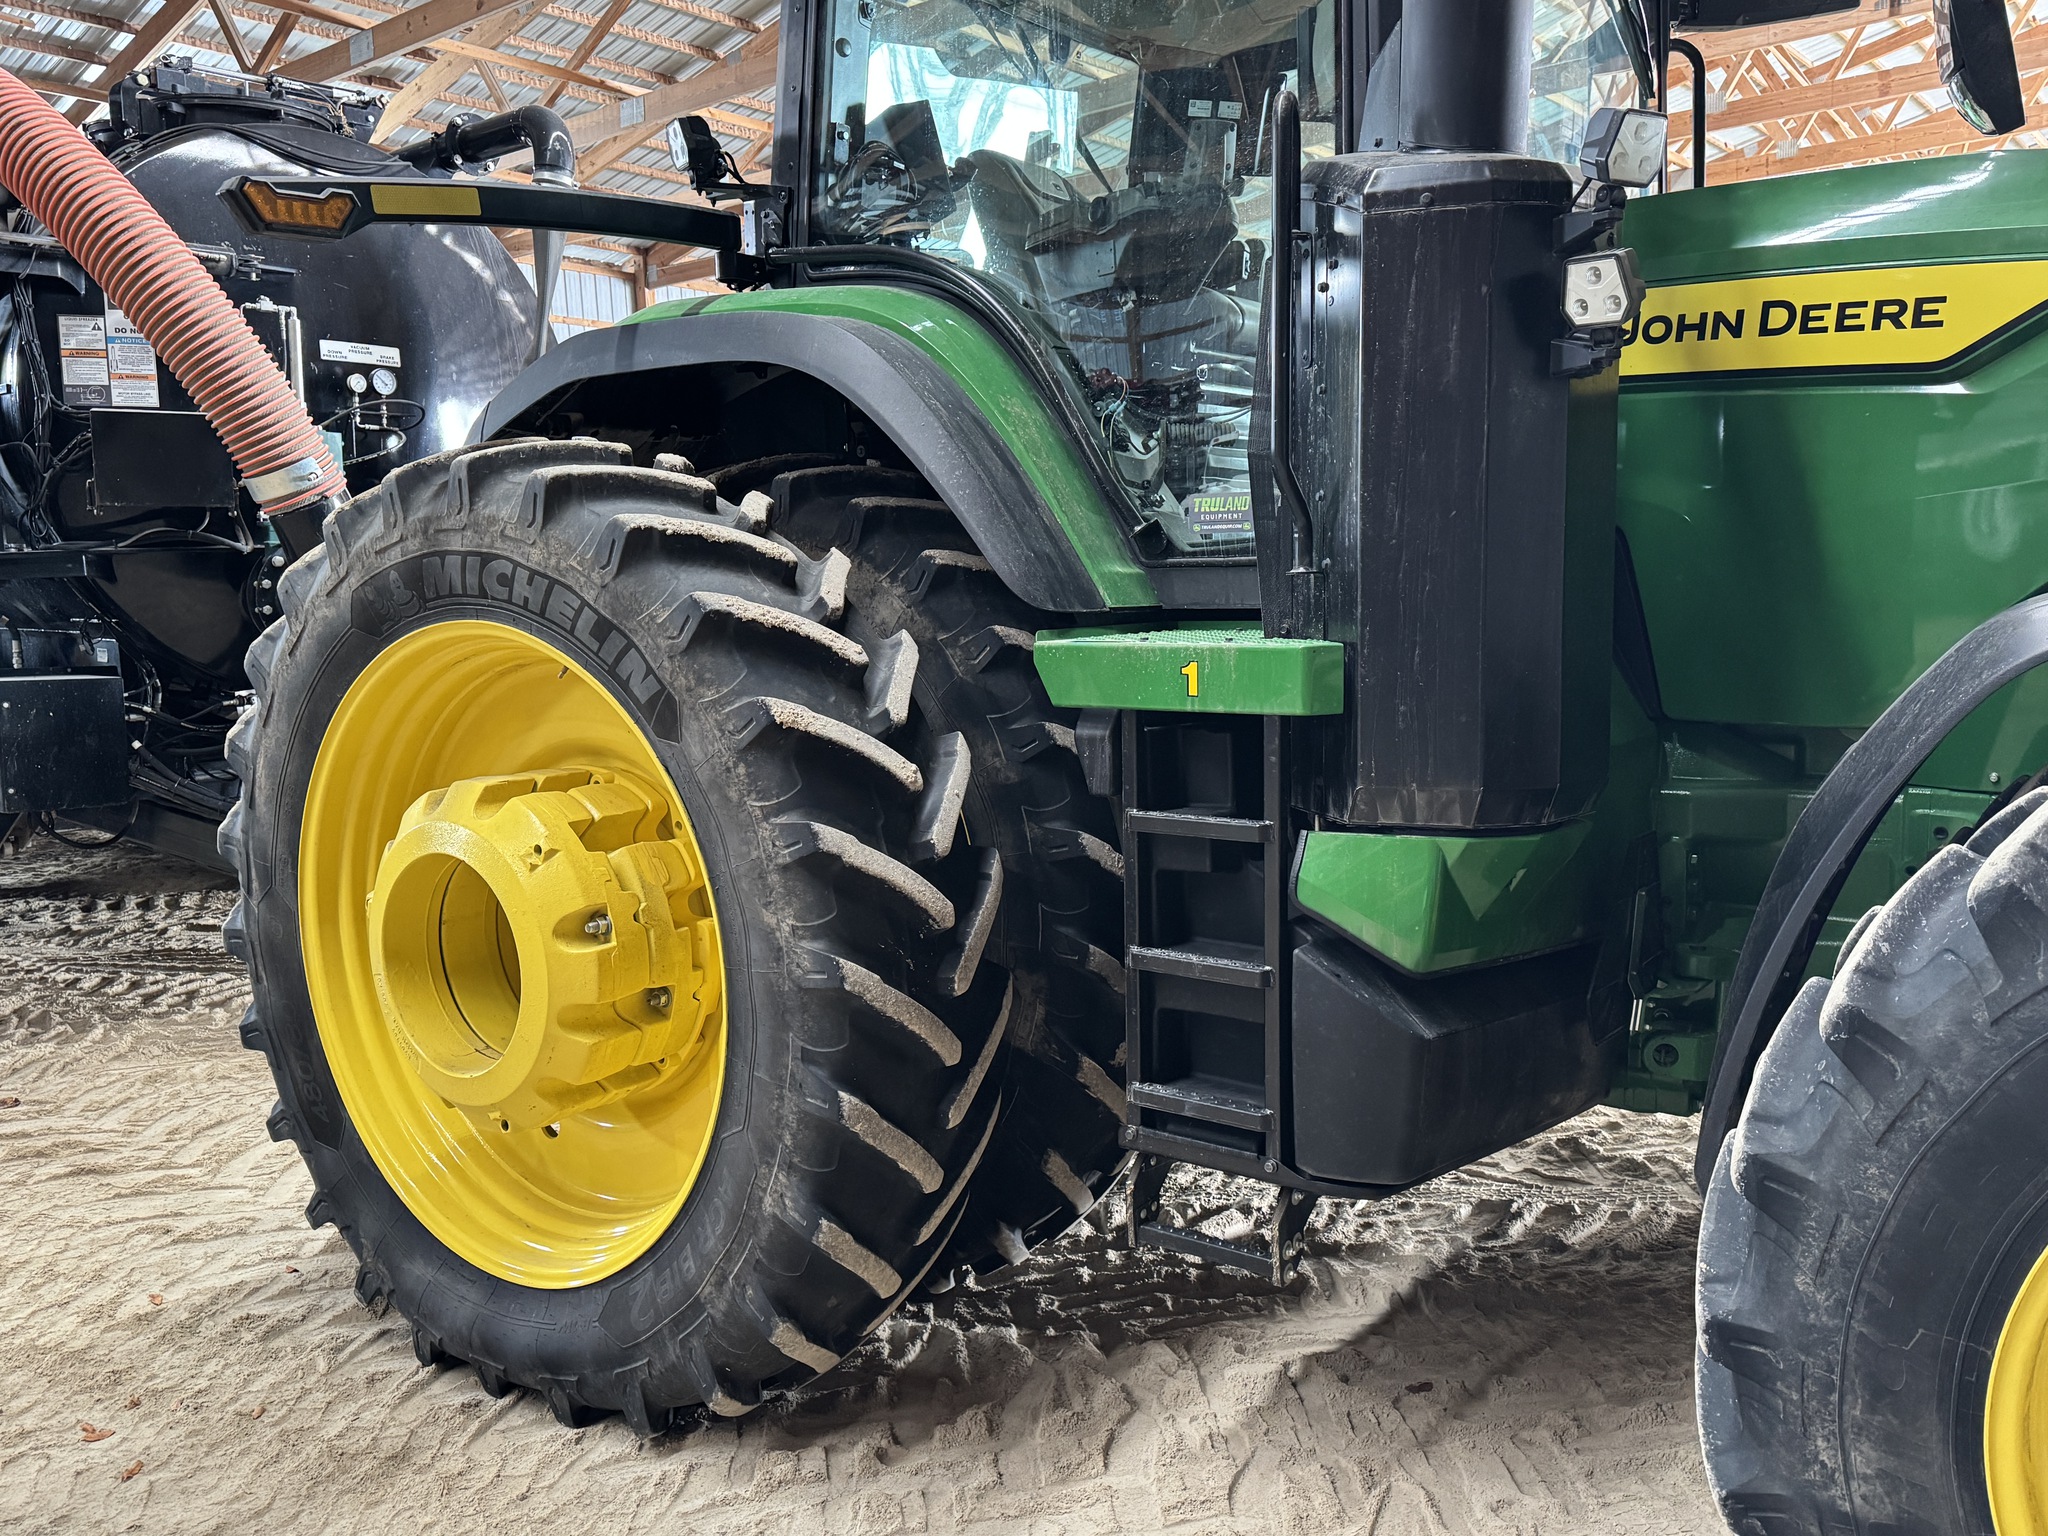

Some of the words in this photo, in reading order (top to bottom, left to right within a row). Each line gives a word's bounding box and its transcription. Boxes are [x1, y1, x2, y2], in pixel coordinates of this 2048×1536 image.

[1622, 309, 1745, 346] JOHN
[1758, 296, 1947, 337] DEERE
[1194, 496, 1250, 512] TRULAND
[422, 555, 662, 704] MICHELIN
[1180, 661, 1199, 698] 1
